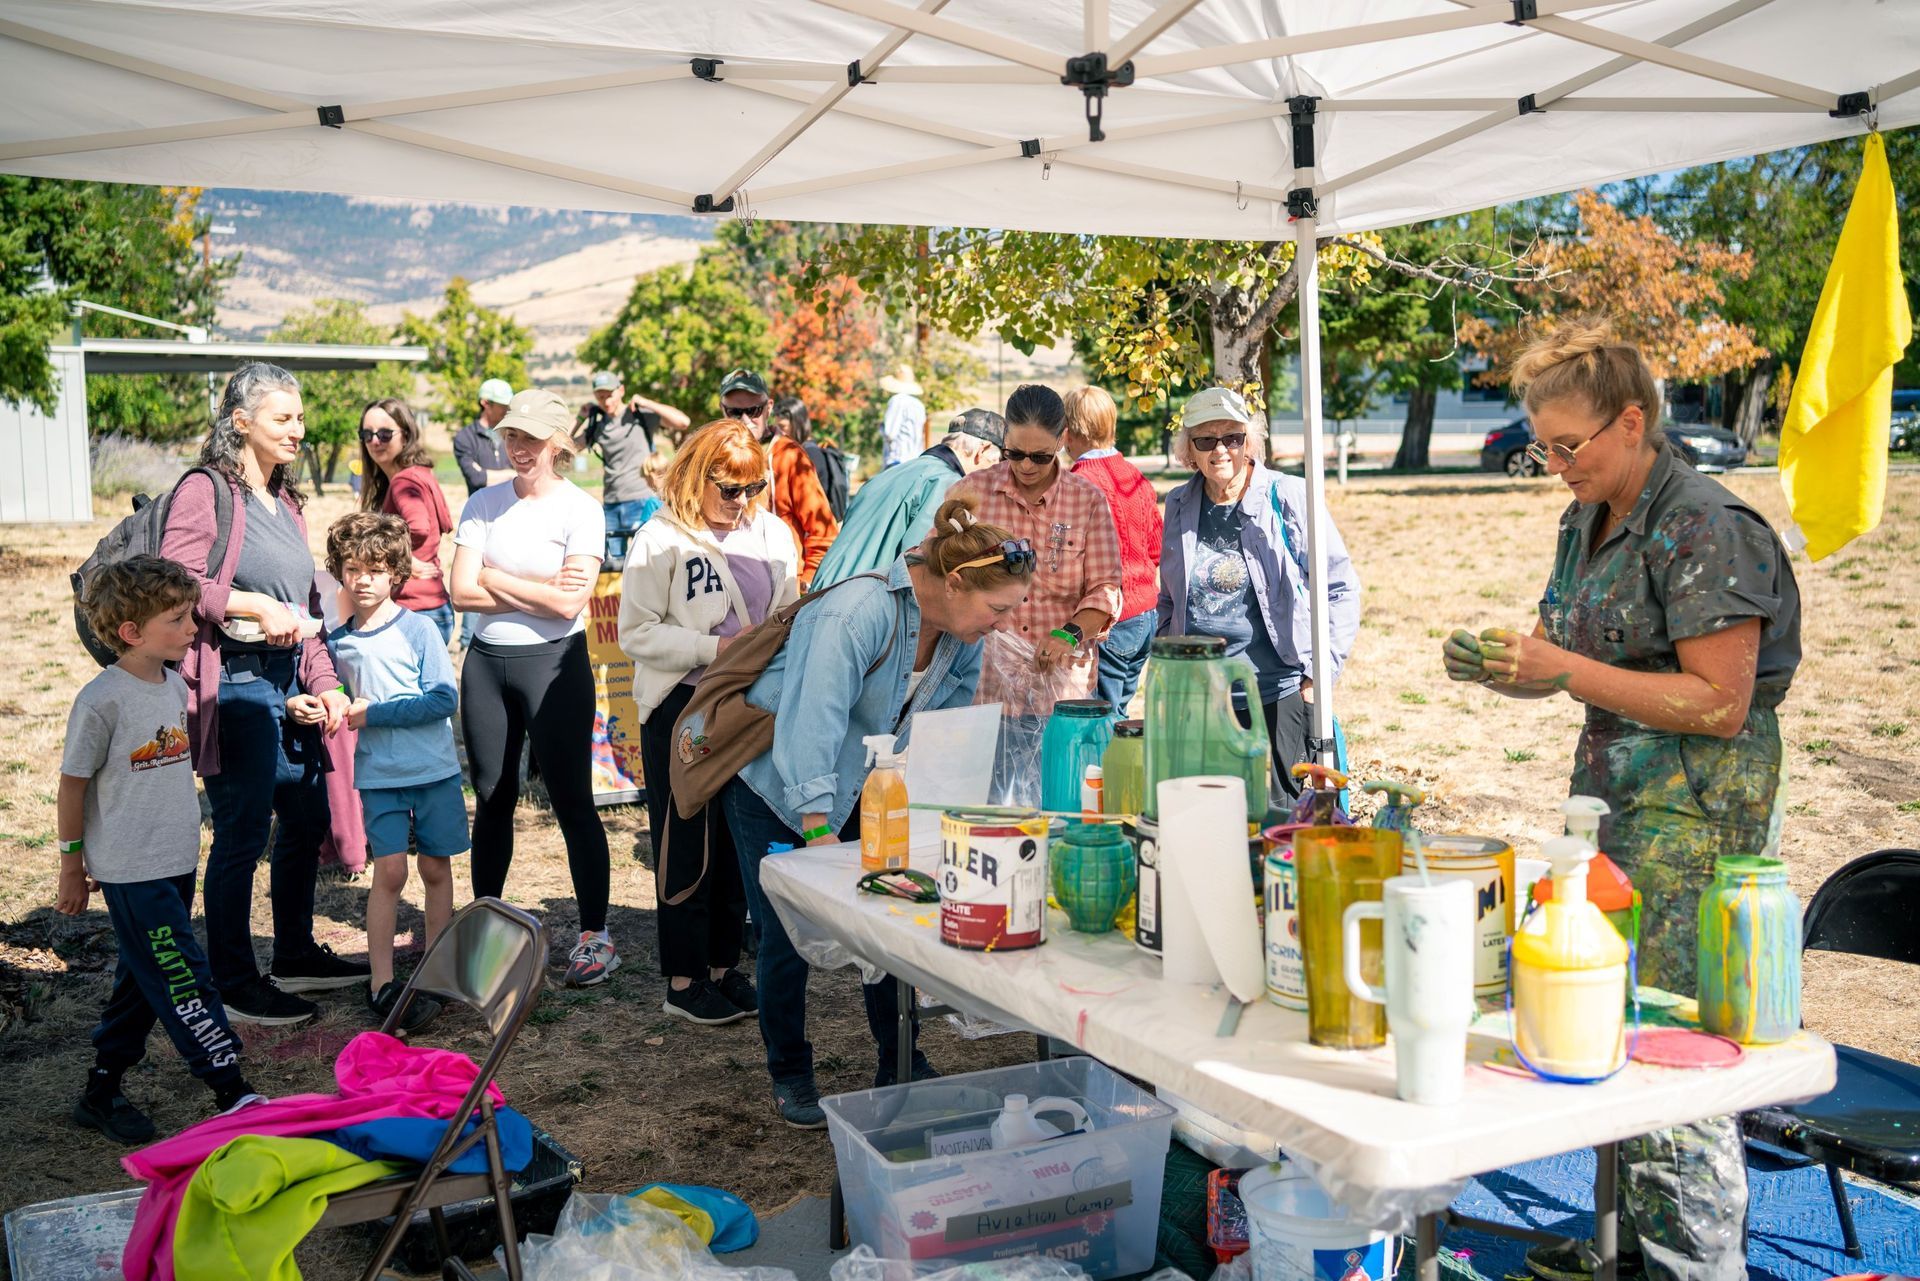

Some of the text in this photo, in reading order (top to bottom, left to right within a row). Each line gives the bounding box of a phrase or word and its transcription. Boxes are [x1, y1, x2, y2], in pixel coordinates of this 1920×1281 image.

[686, 557, 723, 601] PA
[148, 925, 200, 1005] SEATTLE
[976, 1196, 1114, 1235] Aviation Camp
